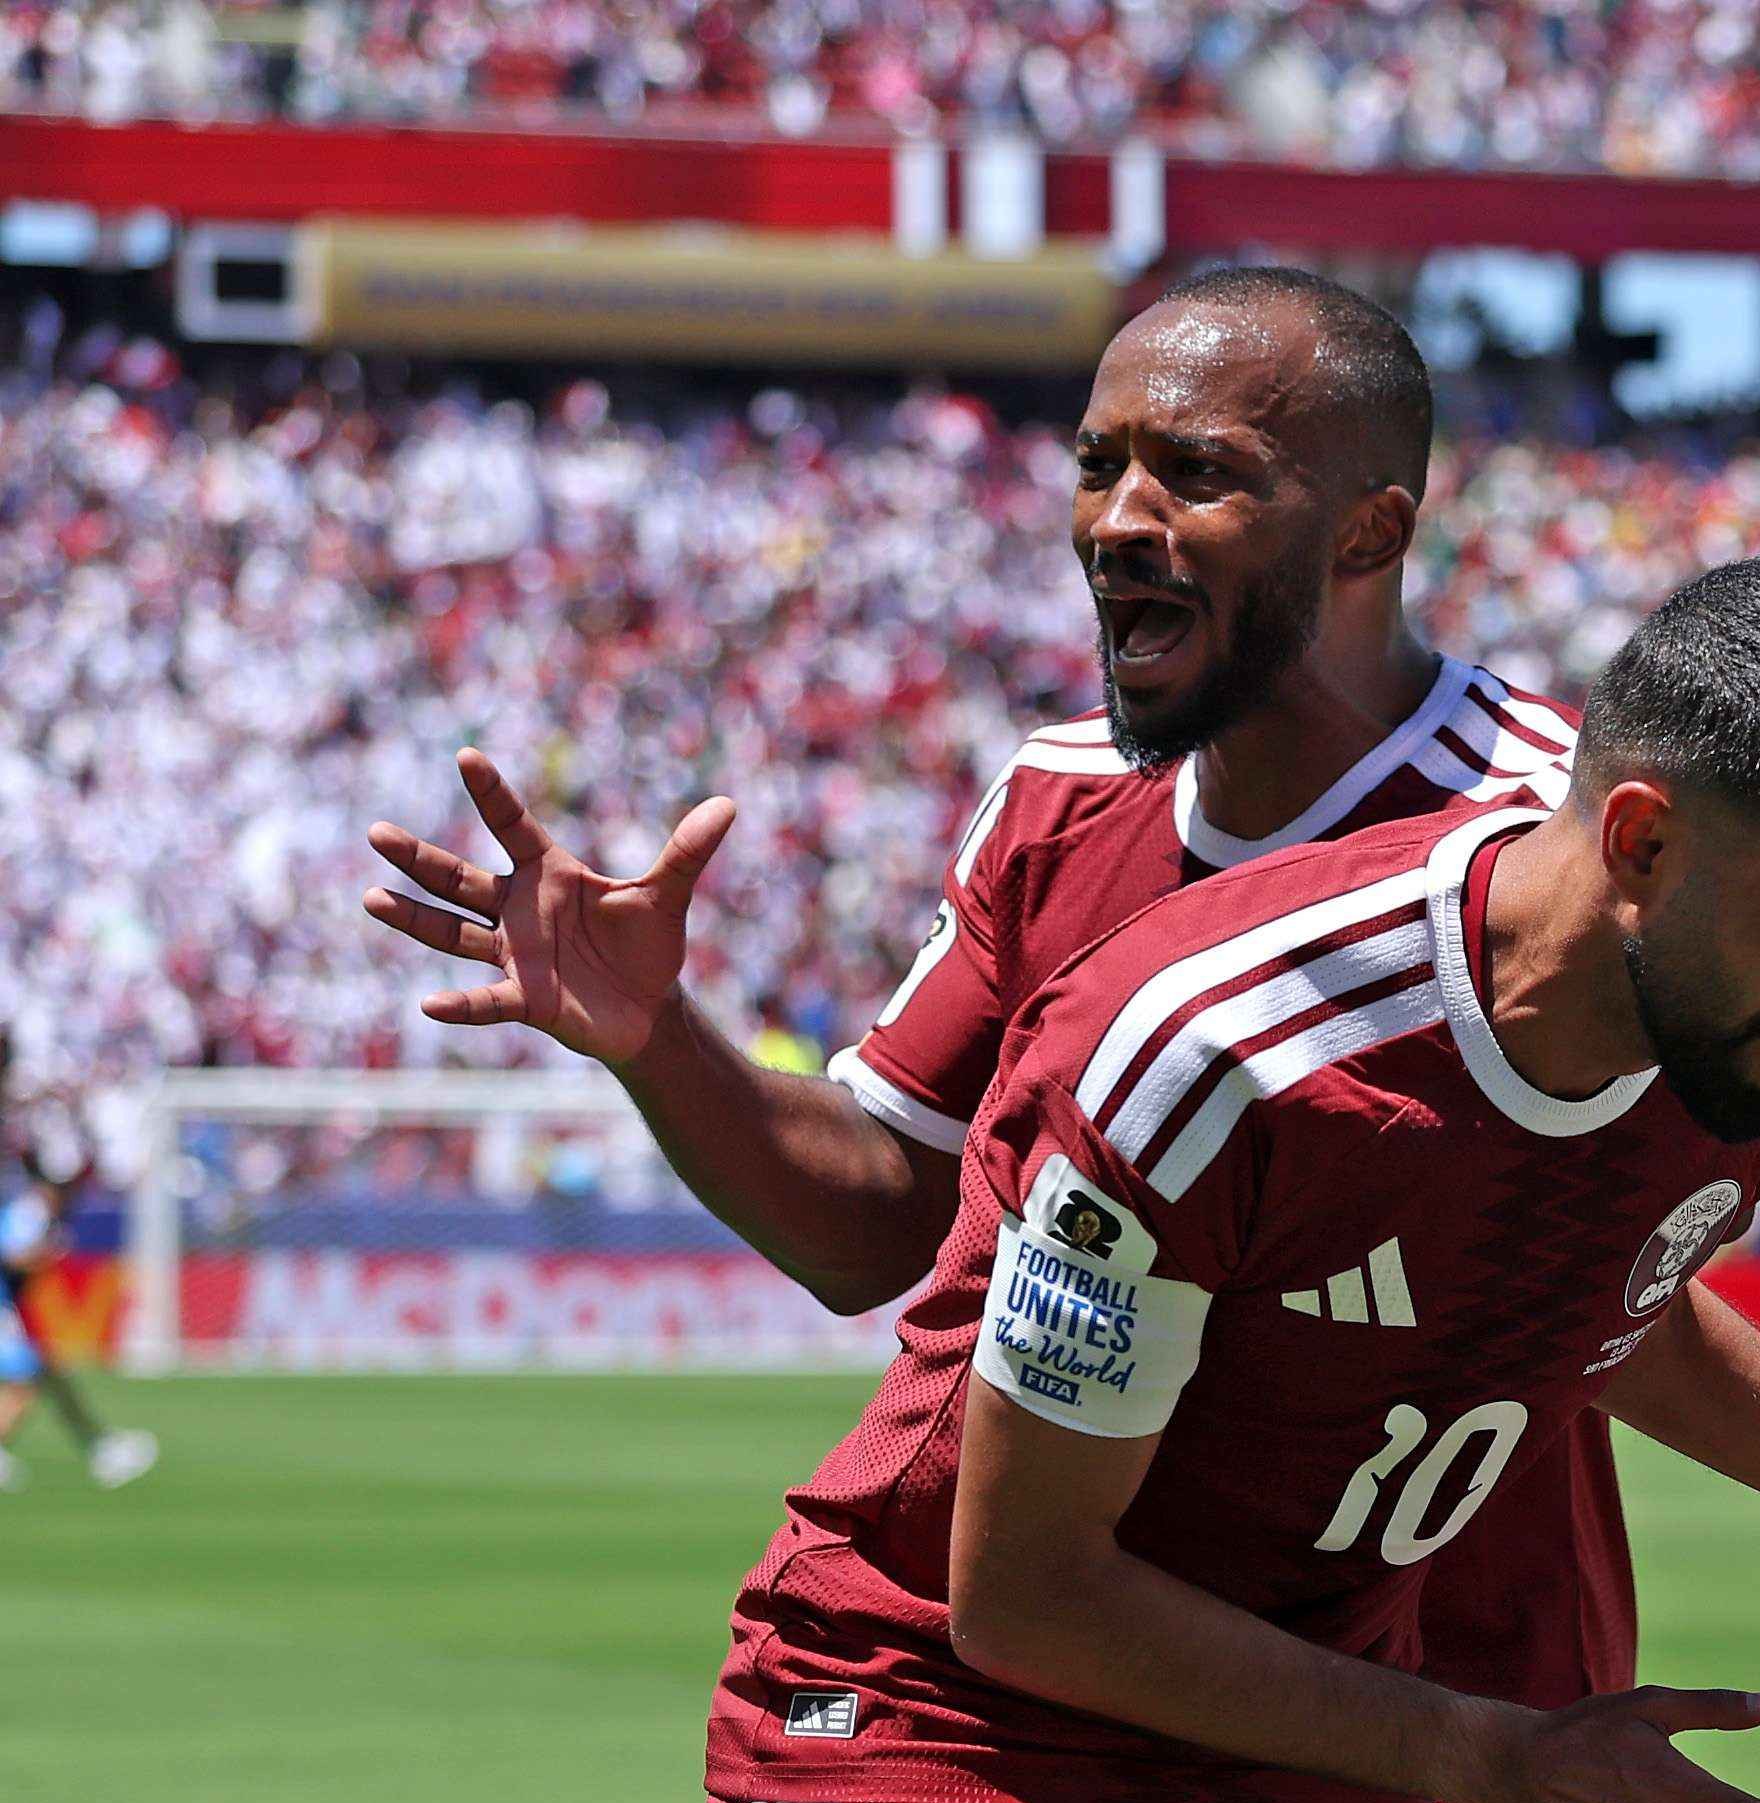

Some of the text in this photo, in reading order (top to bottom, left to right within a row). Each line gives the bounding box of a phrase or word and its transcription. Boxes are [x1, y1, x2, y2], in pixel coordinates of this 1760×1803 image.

[1007, 1272, 1135, 1353] UNITES
[1017, 1242, 1138, 1313] FOOTBALL
[995, 1315, 1137, 1394] the World
[1023, 1369, 1076, 1402] FIFA
[1313, 1401, 1528, 1565] 10
